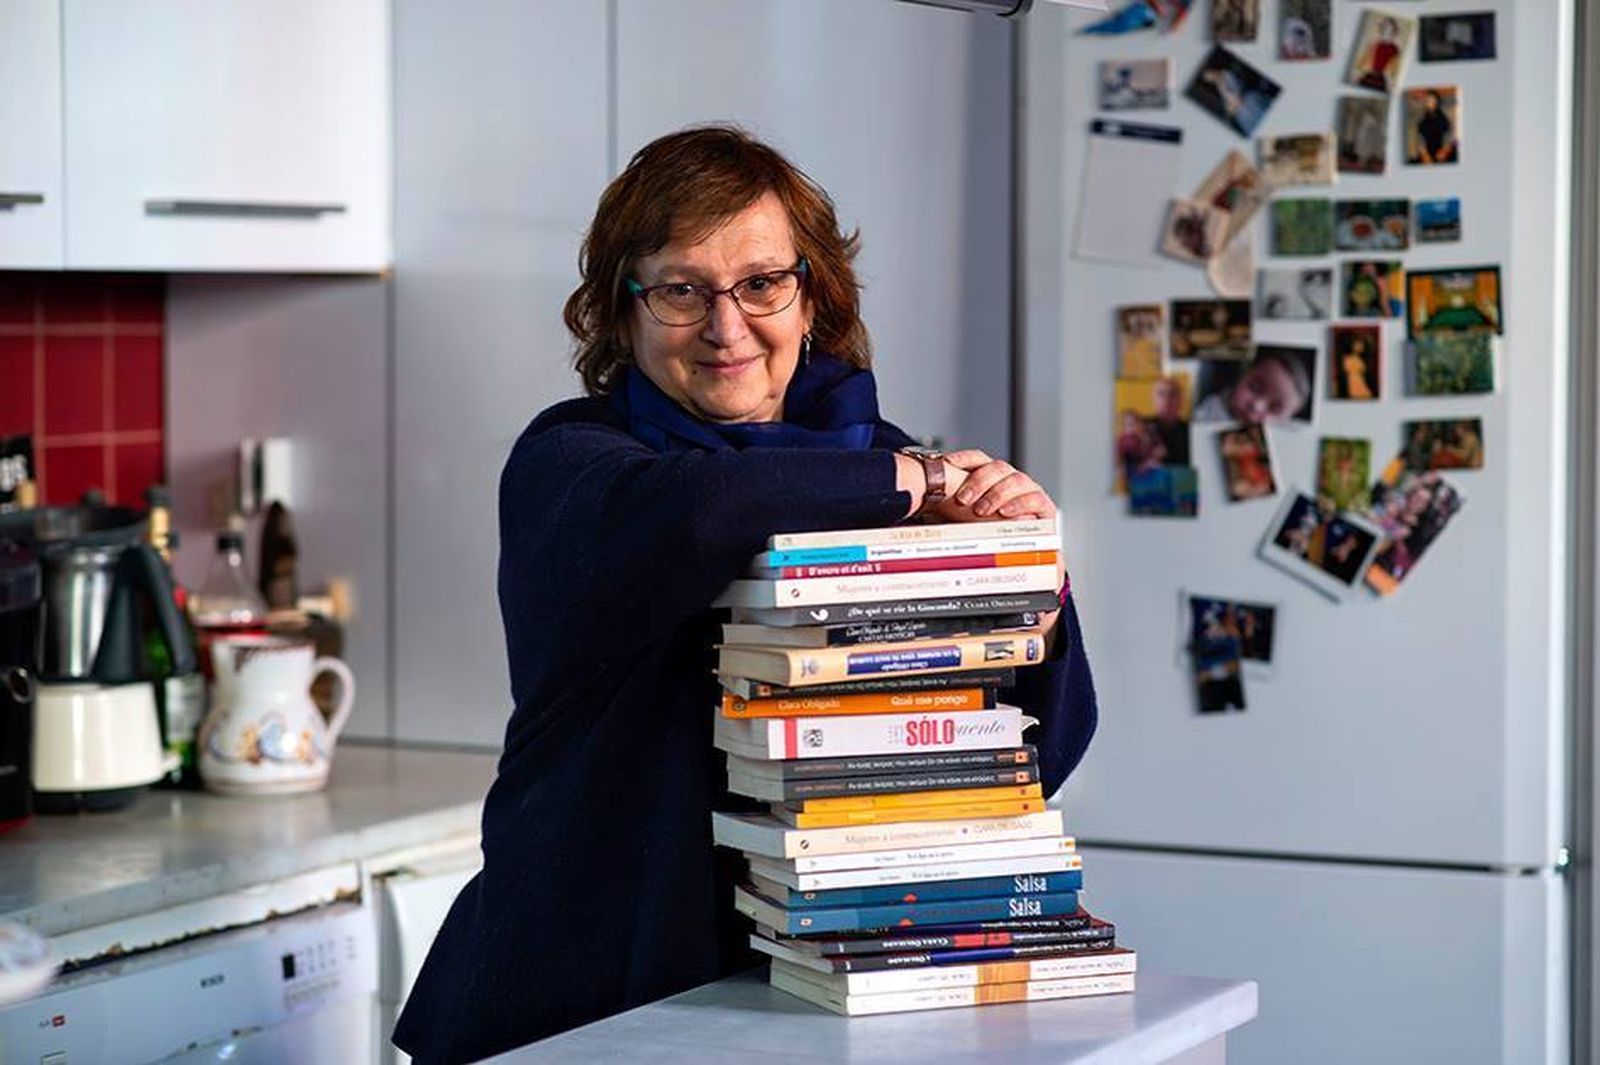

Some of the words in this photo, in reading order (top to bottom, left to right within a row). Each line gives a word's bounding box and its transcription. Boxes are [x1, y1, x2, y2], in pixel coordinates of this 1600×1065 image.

[907, 604, 916, 613] la
[915, 696, 933, 705] me
[934, 694, 968, 707] pongo
[906, 715, 955, 747] SÓLO
[1014, 873, 1048, 893] Salsa
[1009, 897, 1042, 917] Salsa
